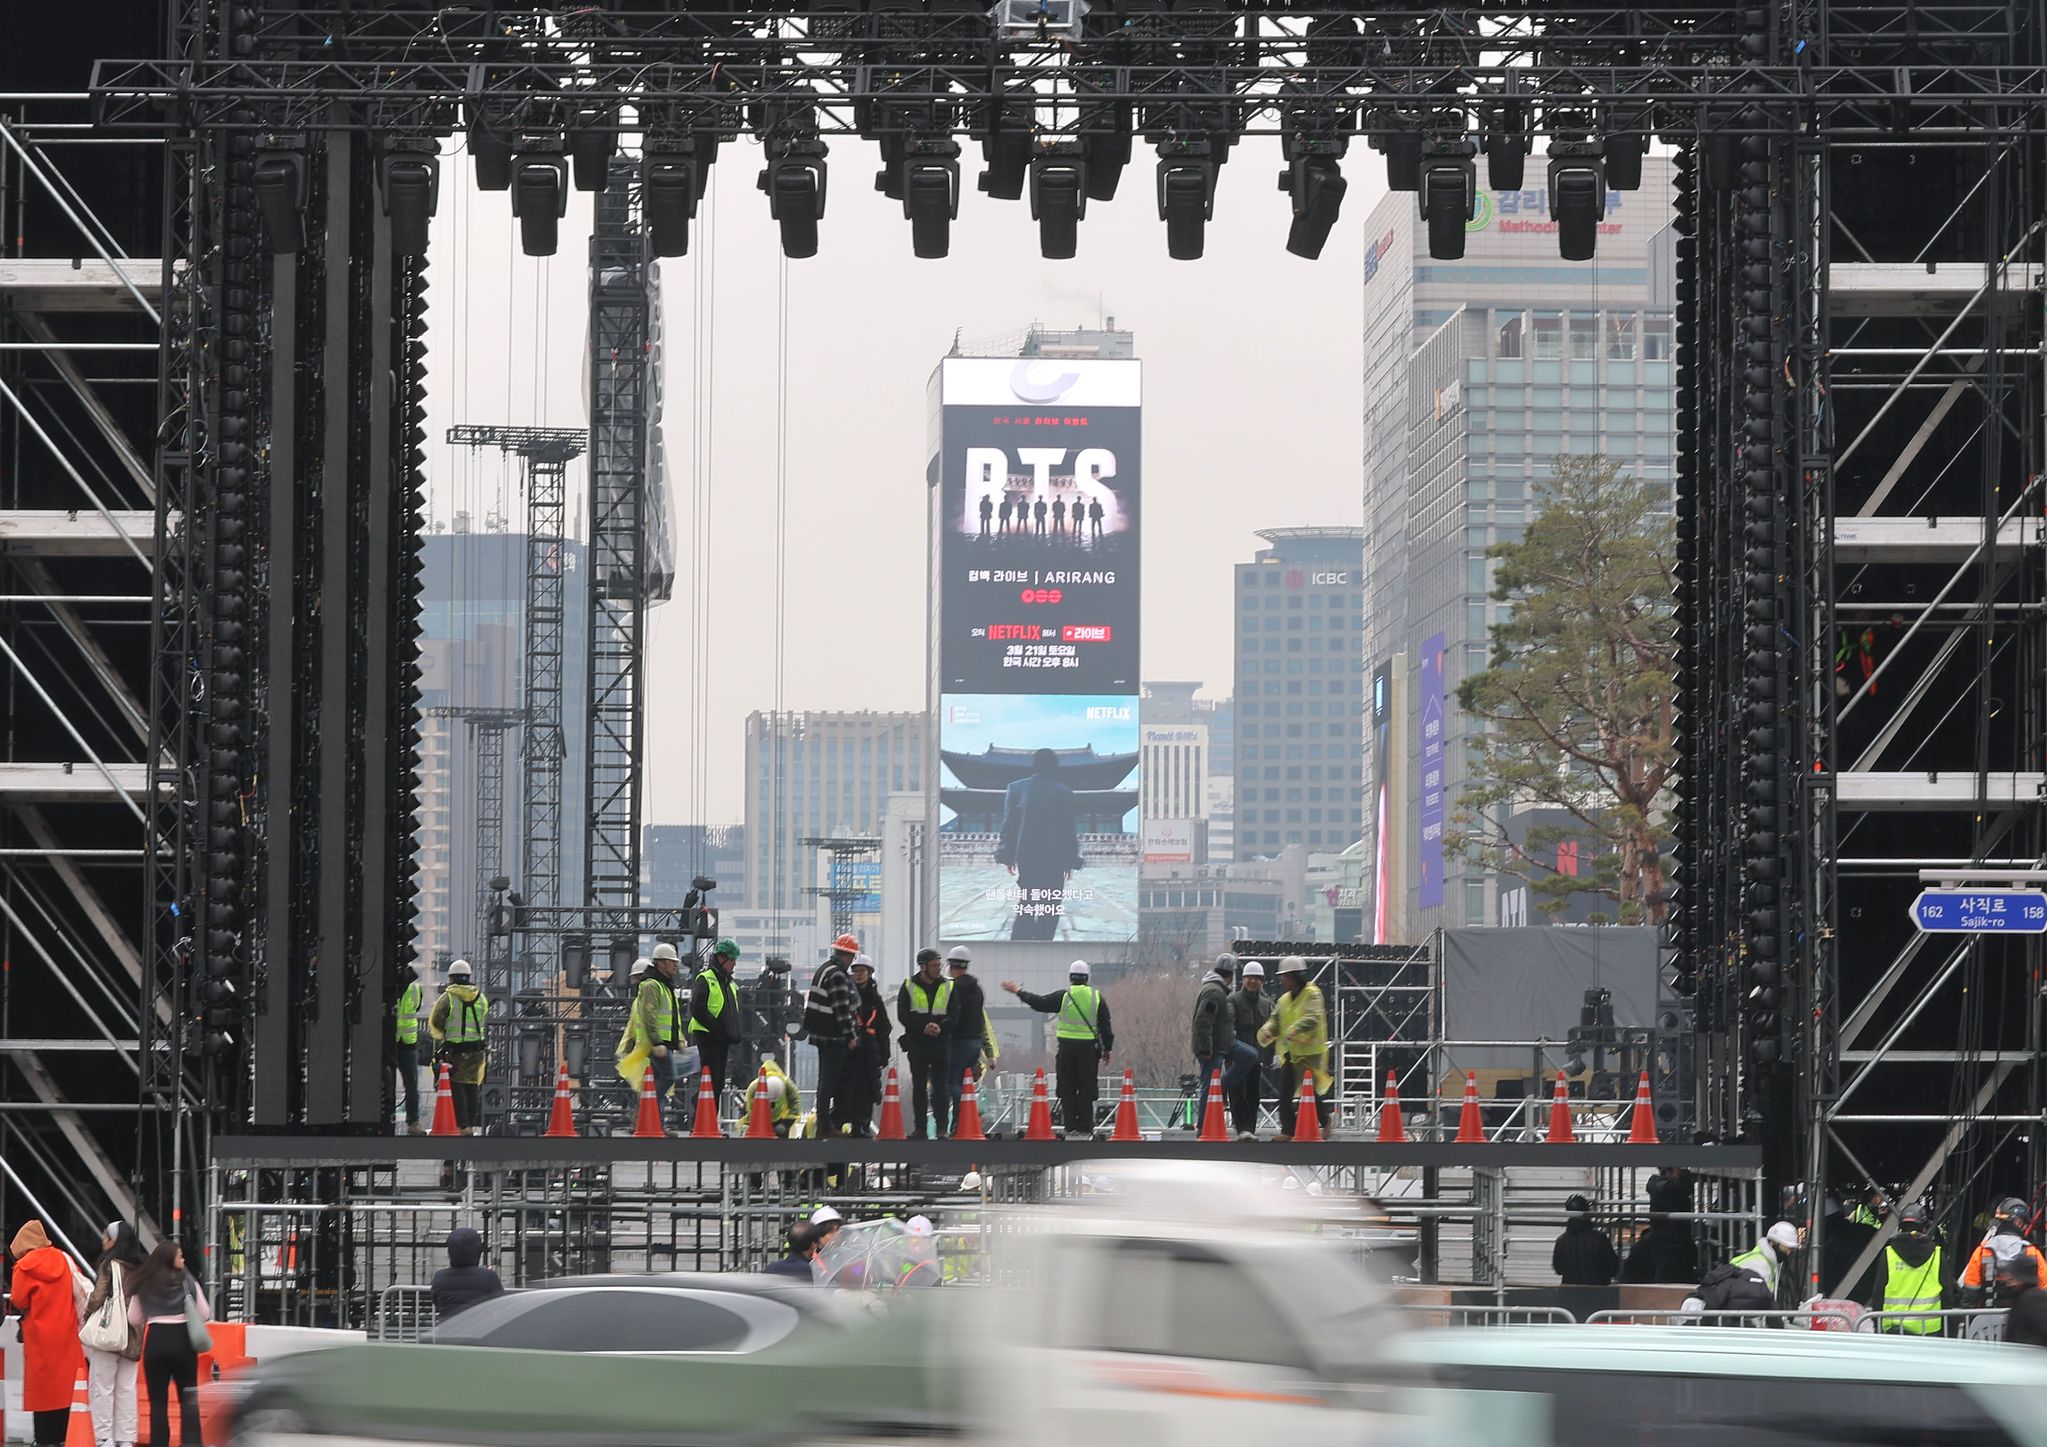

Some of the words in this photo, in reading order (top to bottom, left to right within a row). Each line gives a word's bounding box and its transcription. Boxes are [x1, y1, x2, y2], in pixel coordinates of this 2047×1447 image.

[1498, 188, 1623, 215] 감리부
[963, 447, 1118, 534] BTS
[968, 570, 990, 583] 컴백
[993, 570, 1028, 583] 라이브
[1044, 571, 1116, 584] ARIRANG
[1312, 572, 1347, 586] ICBC
[988, 625, 1041, 641] NETFLIX
[1074, 627, 1106, 640] 라이브
[1006, 644, 1024, 657] 3월
[1025, 644, 1048, 657] 21일
[1048, 644, 1076, 657] 토요일
[1003, 656, 1022, 668] 한국
[1023, 656, 1042, 668] 시간
[1042, 656, 1062, 668] 오후
[1062, 656, 1080, 668] 8시
[1086, 706, 1131, 721] NETFLIX
[1030, 888, 1095, 901] 돌아오겠다고
[1012, 903, 1064, 917] 약속했어요
[1921, 905, 1944, 919] 162
[1959, 896, 2008, 915] 사직로
[2022, 906, 2045, 920] 158
[1960, 915, 2006, 929] Sajik-ro
